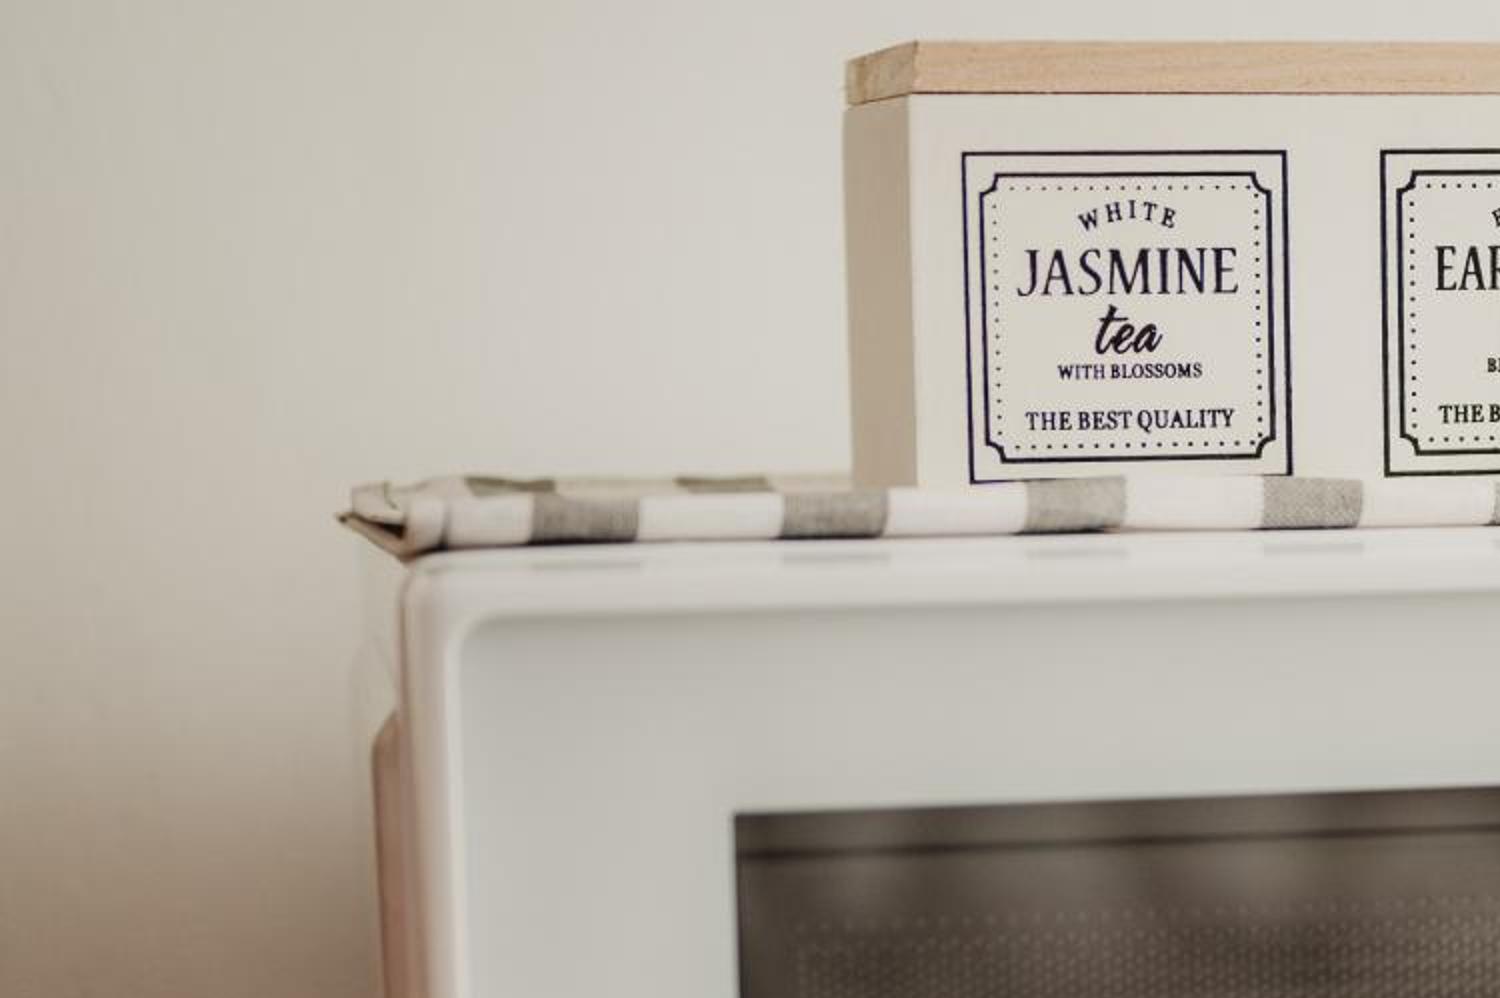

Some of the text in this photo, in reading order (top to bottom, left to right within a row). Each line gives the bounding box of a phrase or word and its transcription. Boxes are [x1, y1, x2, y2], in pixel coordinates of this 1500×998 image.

[1077, 199, 1176, 231] WHITE
[1017, 247, 1239, 297] JASMINE
[1094, 304, 1163, 355] tea
[1057, 362, 1203, 380] WITH BLOSSOMS
[1025, 408, 1235, 434] THE BEST QUALITY
[1438, 404, 1485, 424] THE
